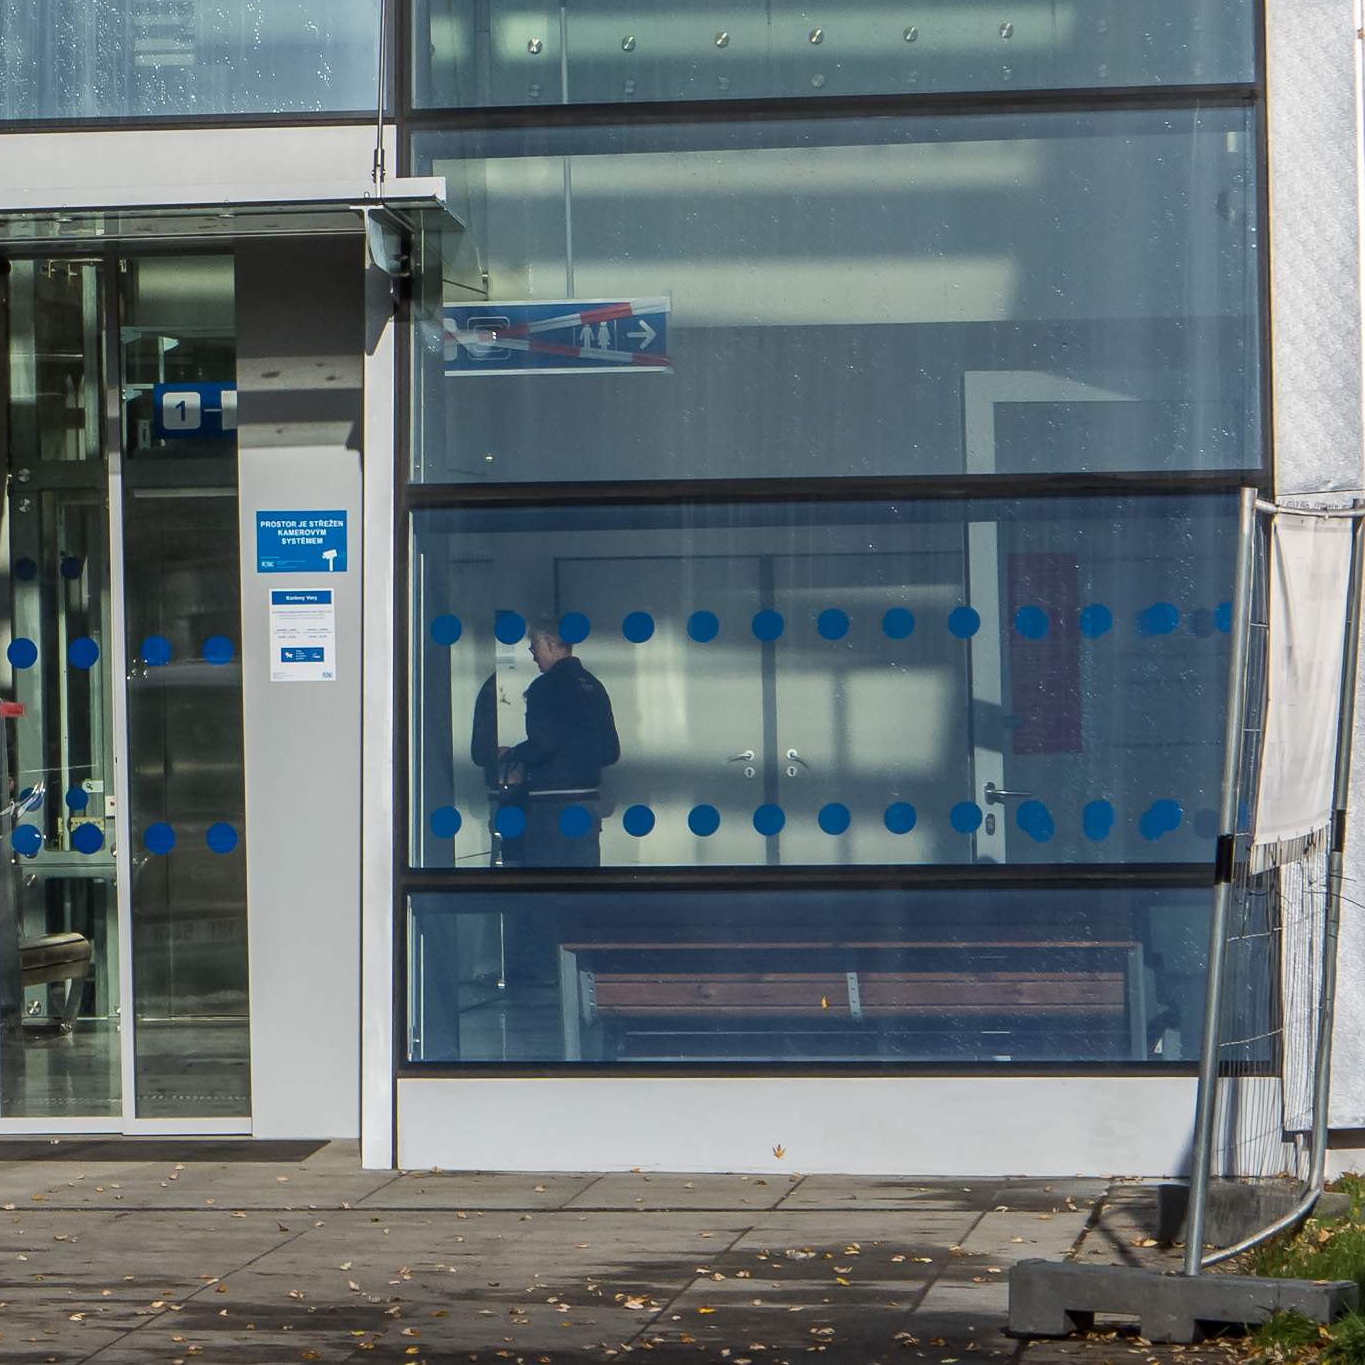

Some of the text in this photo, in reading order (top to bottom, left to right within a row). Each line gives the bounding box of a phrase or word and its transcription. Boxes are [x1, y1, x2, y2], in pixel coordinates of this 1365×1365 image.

[175, 400, 186, 422] 1
[260, 520, 297, 528] PROSTOR
[309, 519, 344, 527] STŘEŽEN
[277, 528, 327, 536] KAMEROVÝM
[281, 536, 323, 545] SYSTÉMEM
